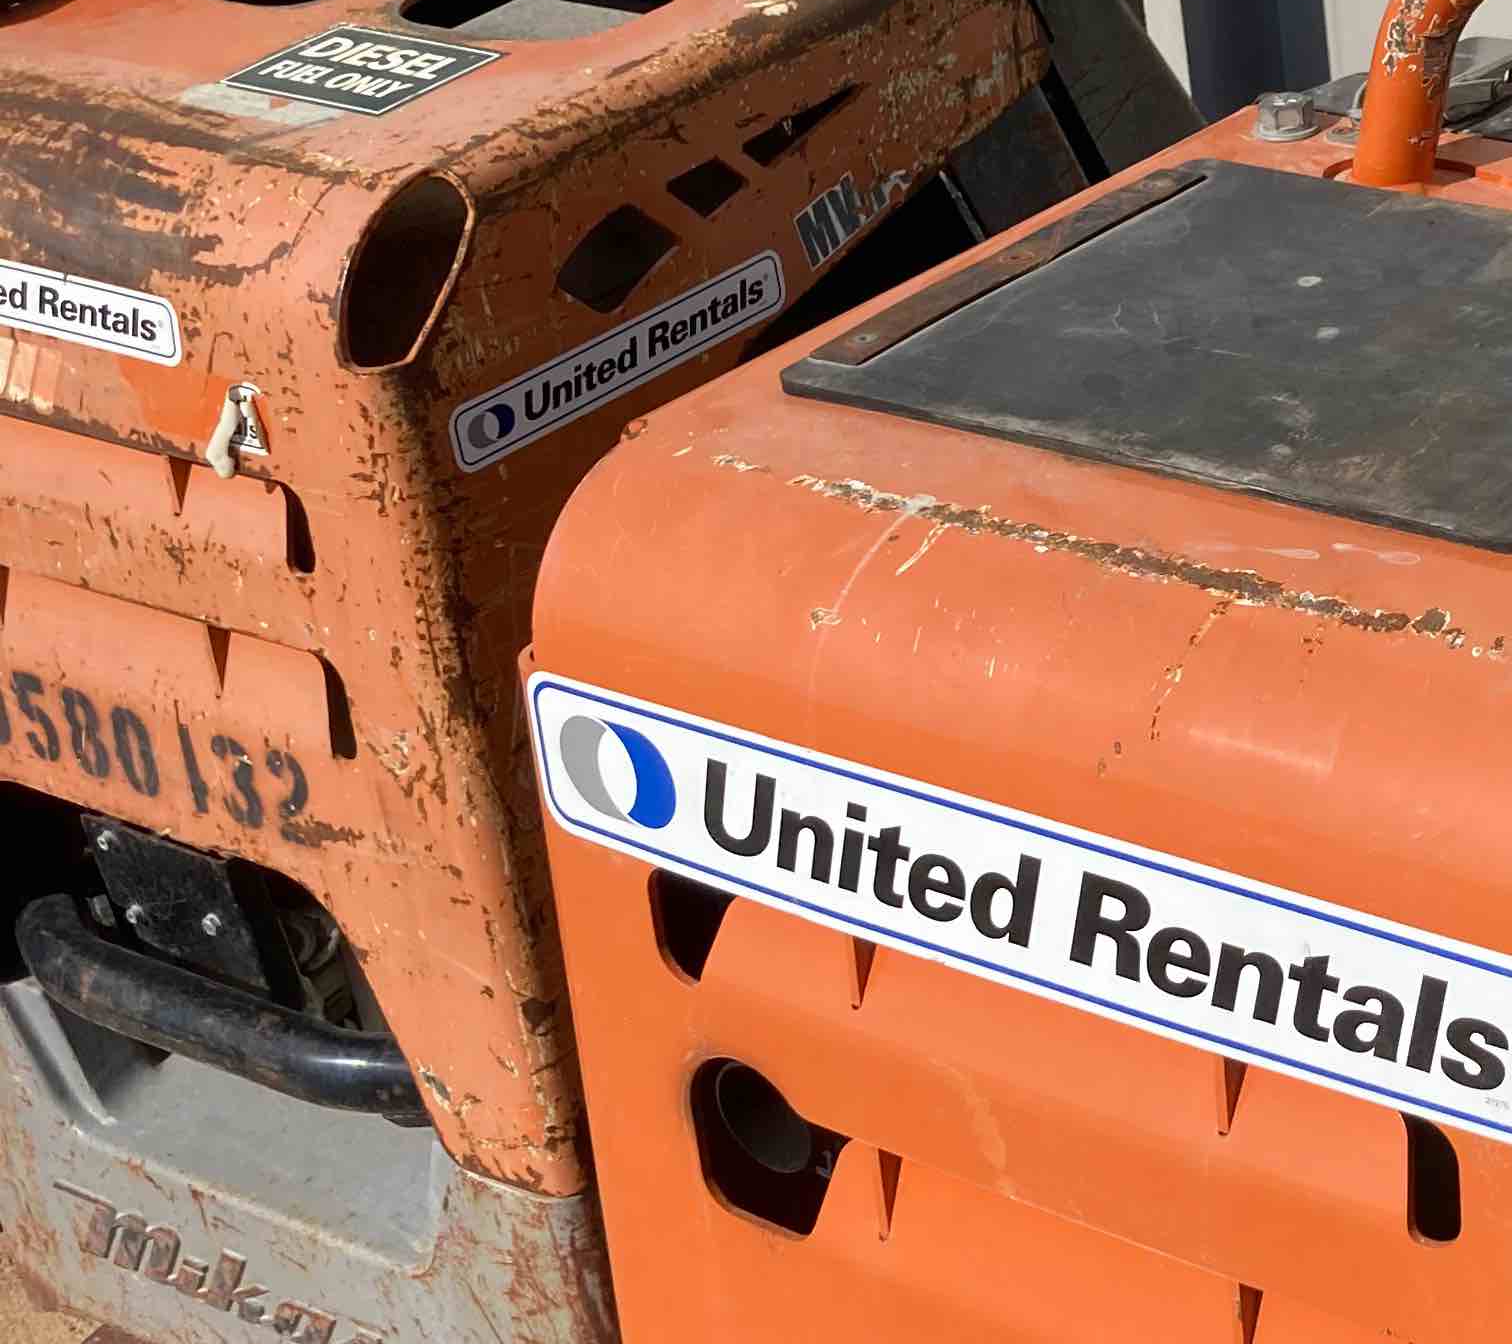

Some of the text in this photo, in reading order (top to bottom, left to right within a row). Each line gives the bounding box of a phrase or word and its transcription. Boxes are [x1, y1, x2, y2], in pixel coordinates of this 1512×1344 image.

[258, 59, 416, 98] FUEL ONLY
[298, 36, 457, 81] DIESEL
[38, 285, 158, 342] Rentals
[524, 278, 765, 422] United Rentals
[703, 756, 1511, 1093] United Rentals
